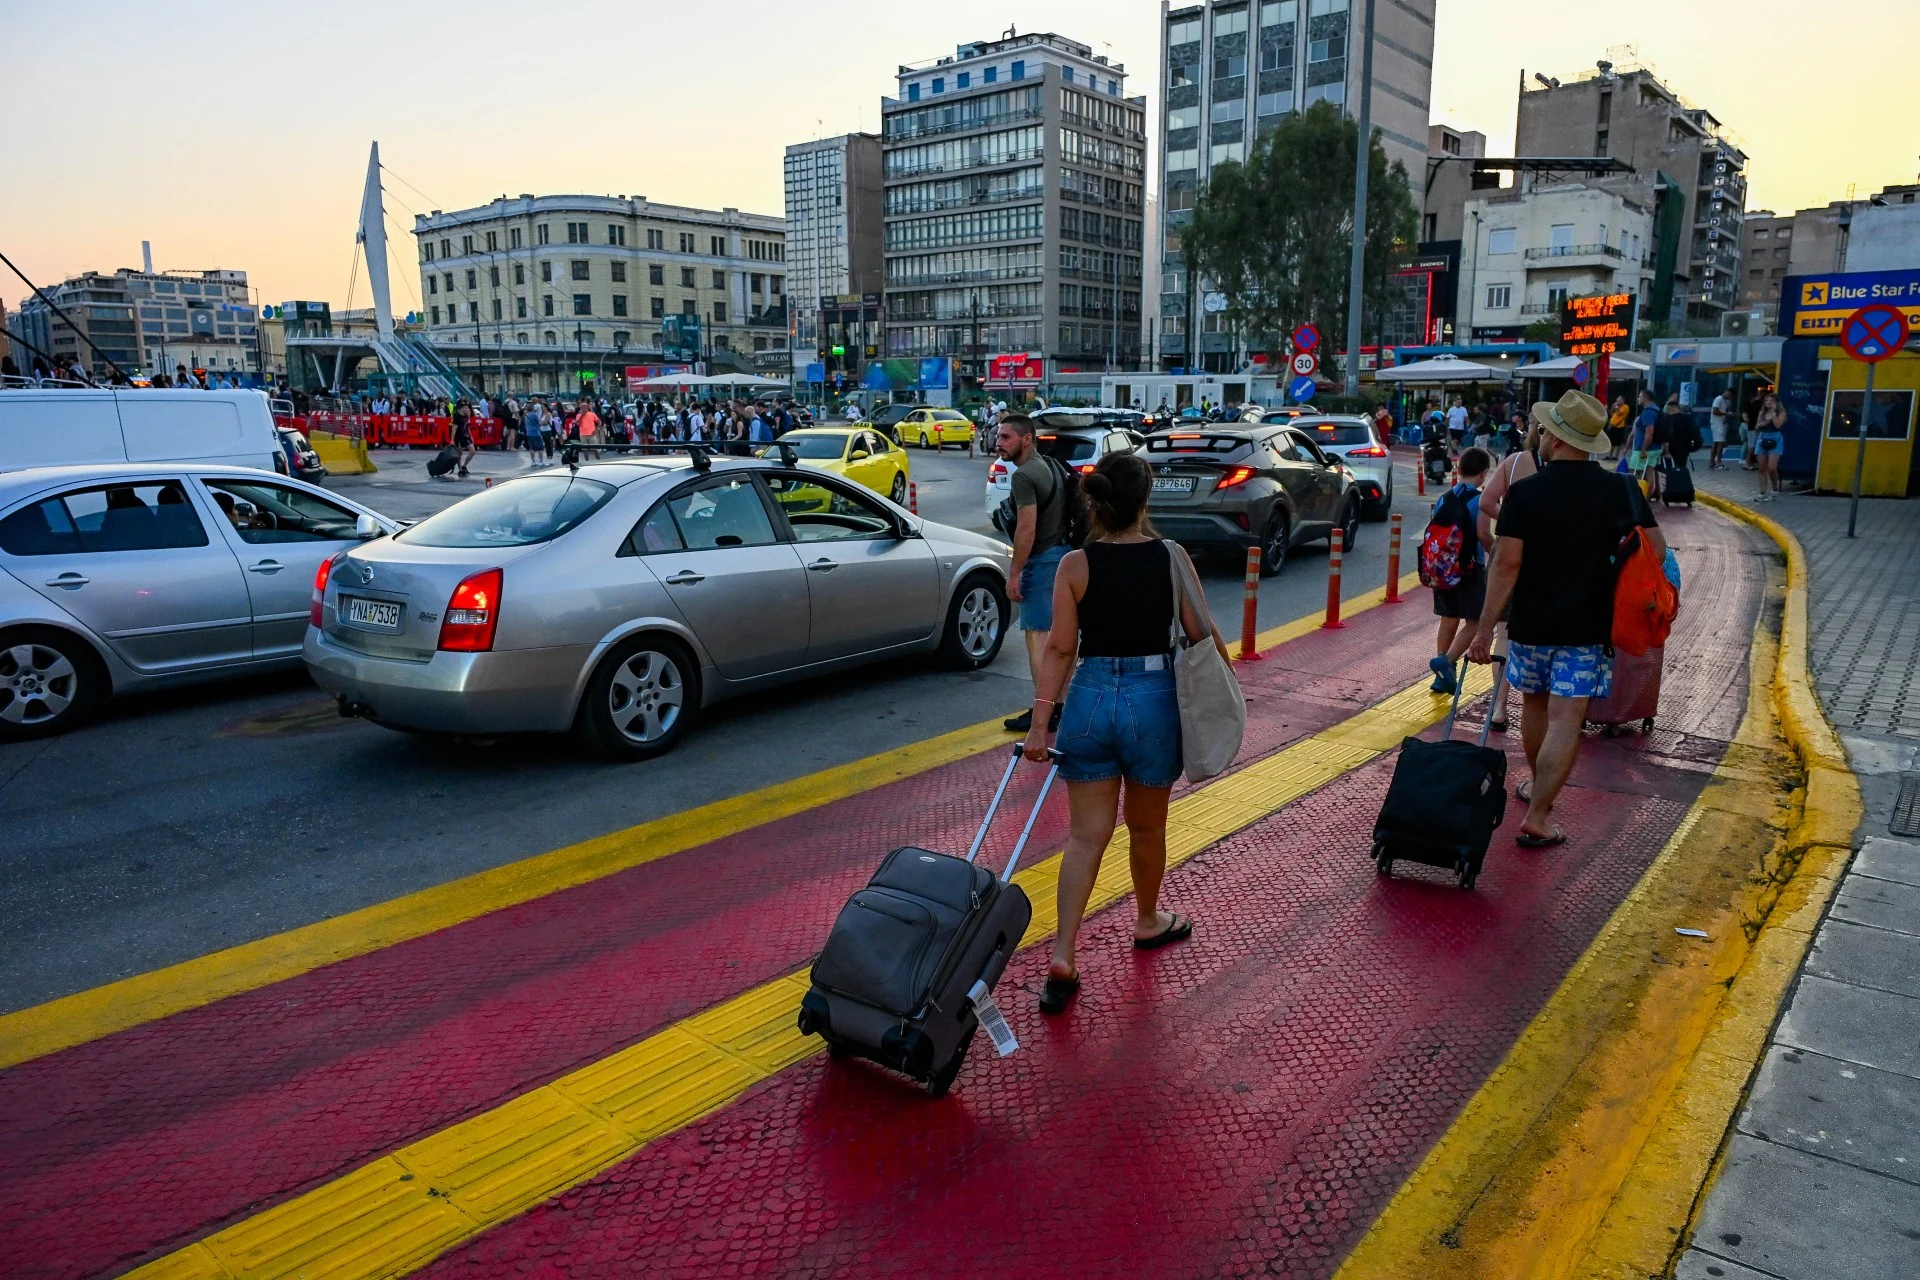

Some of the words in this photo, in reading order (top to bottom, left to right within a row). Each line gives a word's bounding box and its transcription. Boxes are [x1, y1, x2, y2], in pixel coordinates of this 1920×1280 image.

[1831, 286, 1868, 299] Blue
[1871, 284, 1905, 297] Star
[1909, 282, 1920, 296] F
[1297, 359, 1312, 369] 30
[1151, 479, 1191, 489] ZB-7646
